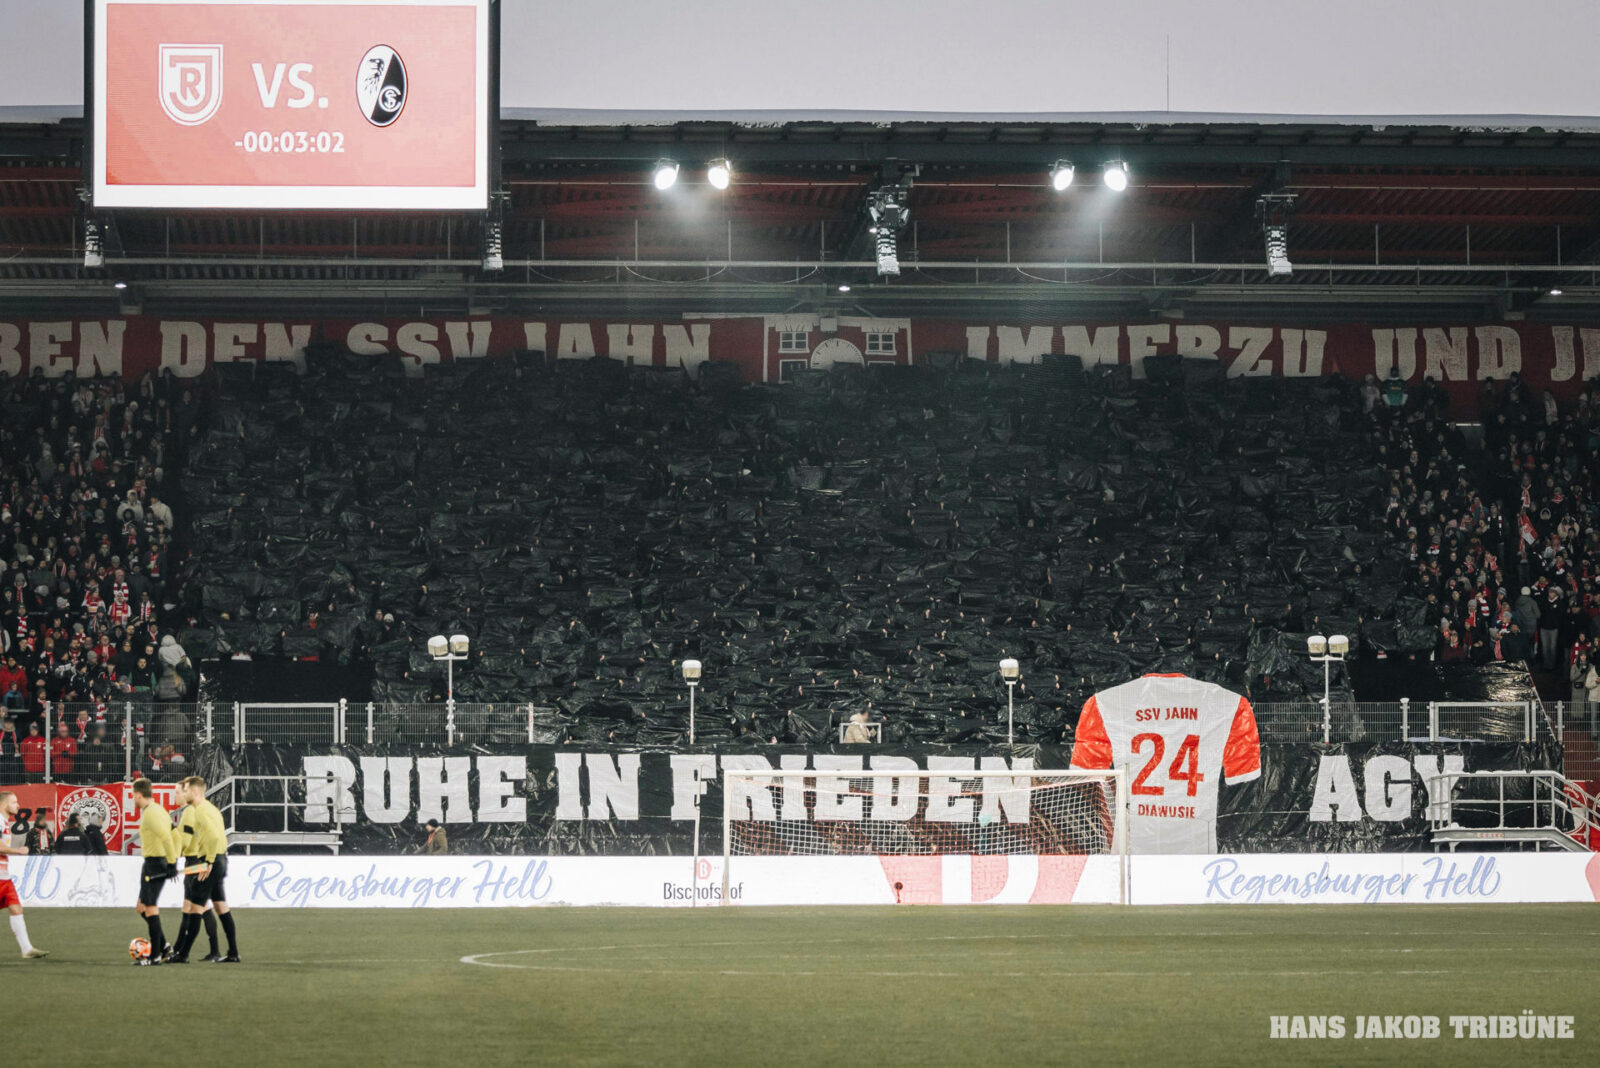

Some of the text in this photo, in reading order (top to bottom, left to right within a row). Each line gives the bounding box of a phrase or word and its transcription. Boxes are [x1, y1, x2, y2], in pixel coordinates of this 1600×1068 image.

[252, 63, 329, 108] VS.
[234, 131, 345, 153] -00:03:02
[159, 320, 312, 378] DEN
[346, 321, 492, 378] SSV
[1372, 326, 1522, 382] UND
[1136, 707, 1198, 722] SSV JAHN
[304, 753, 1464, 824] RUHE IN FRIEDEN AGY
[1131, 732, 1205, 797] 24
[1138, 804, 1196, 819] DIAWUSIE
[248, 859, 552, 907] Regensburger Hell
[1202, 855, 1500, 903] Regensburger Hell
